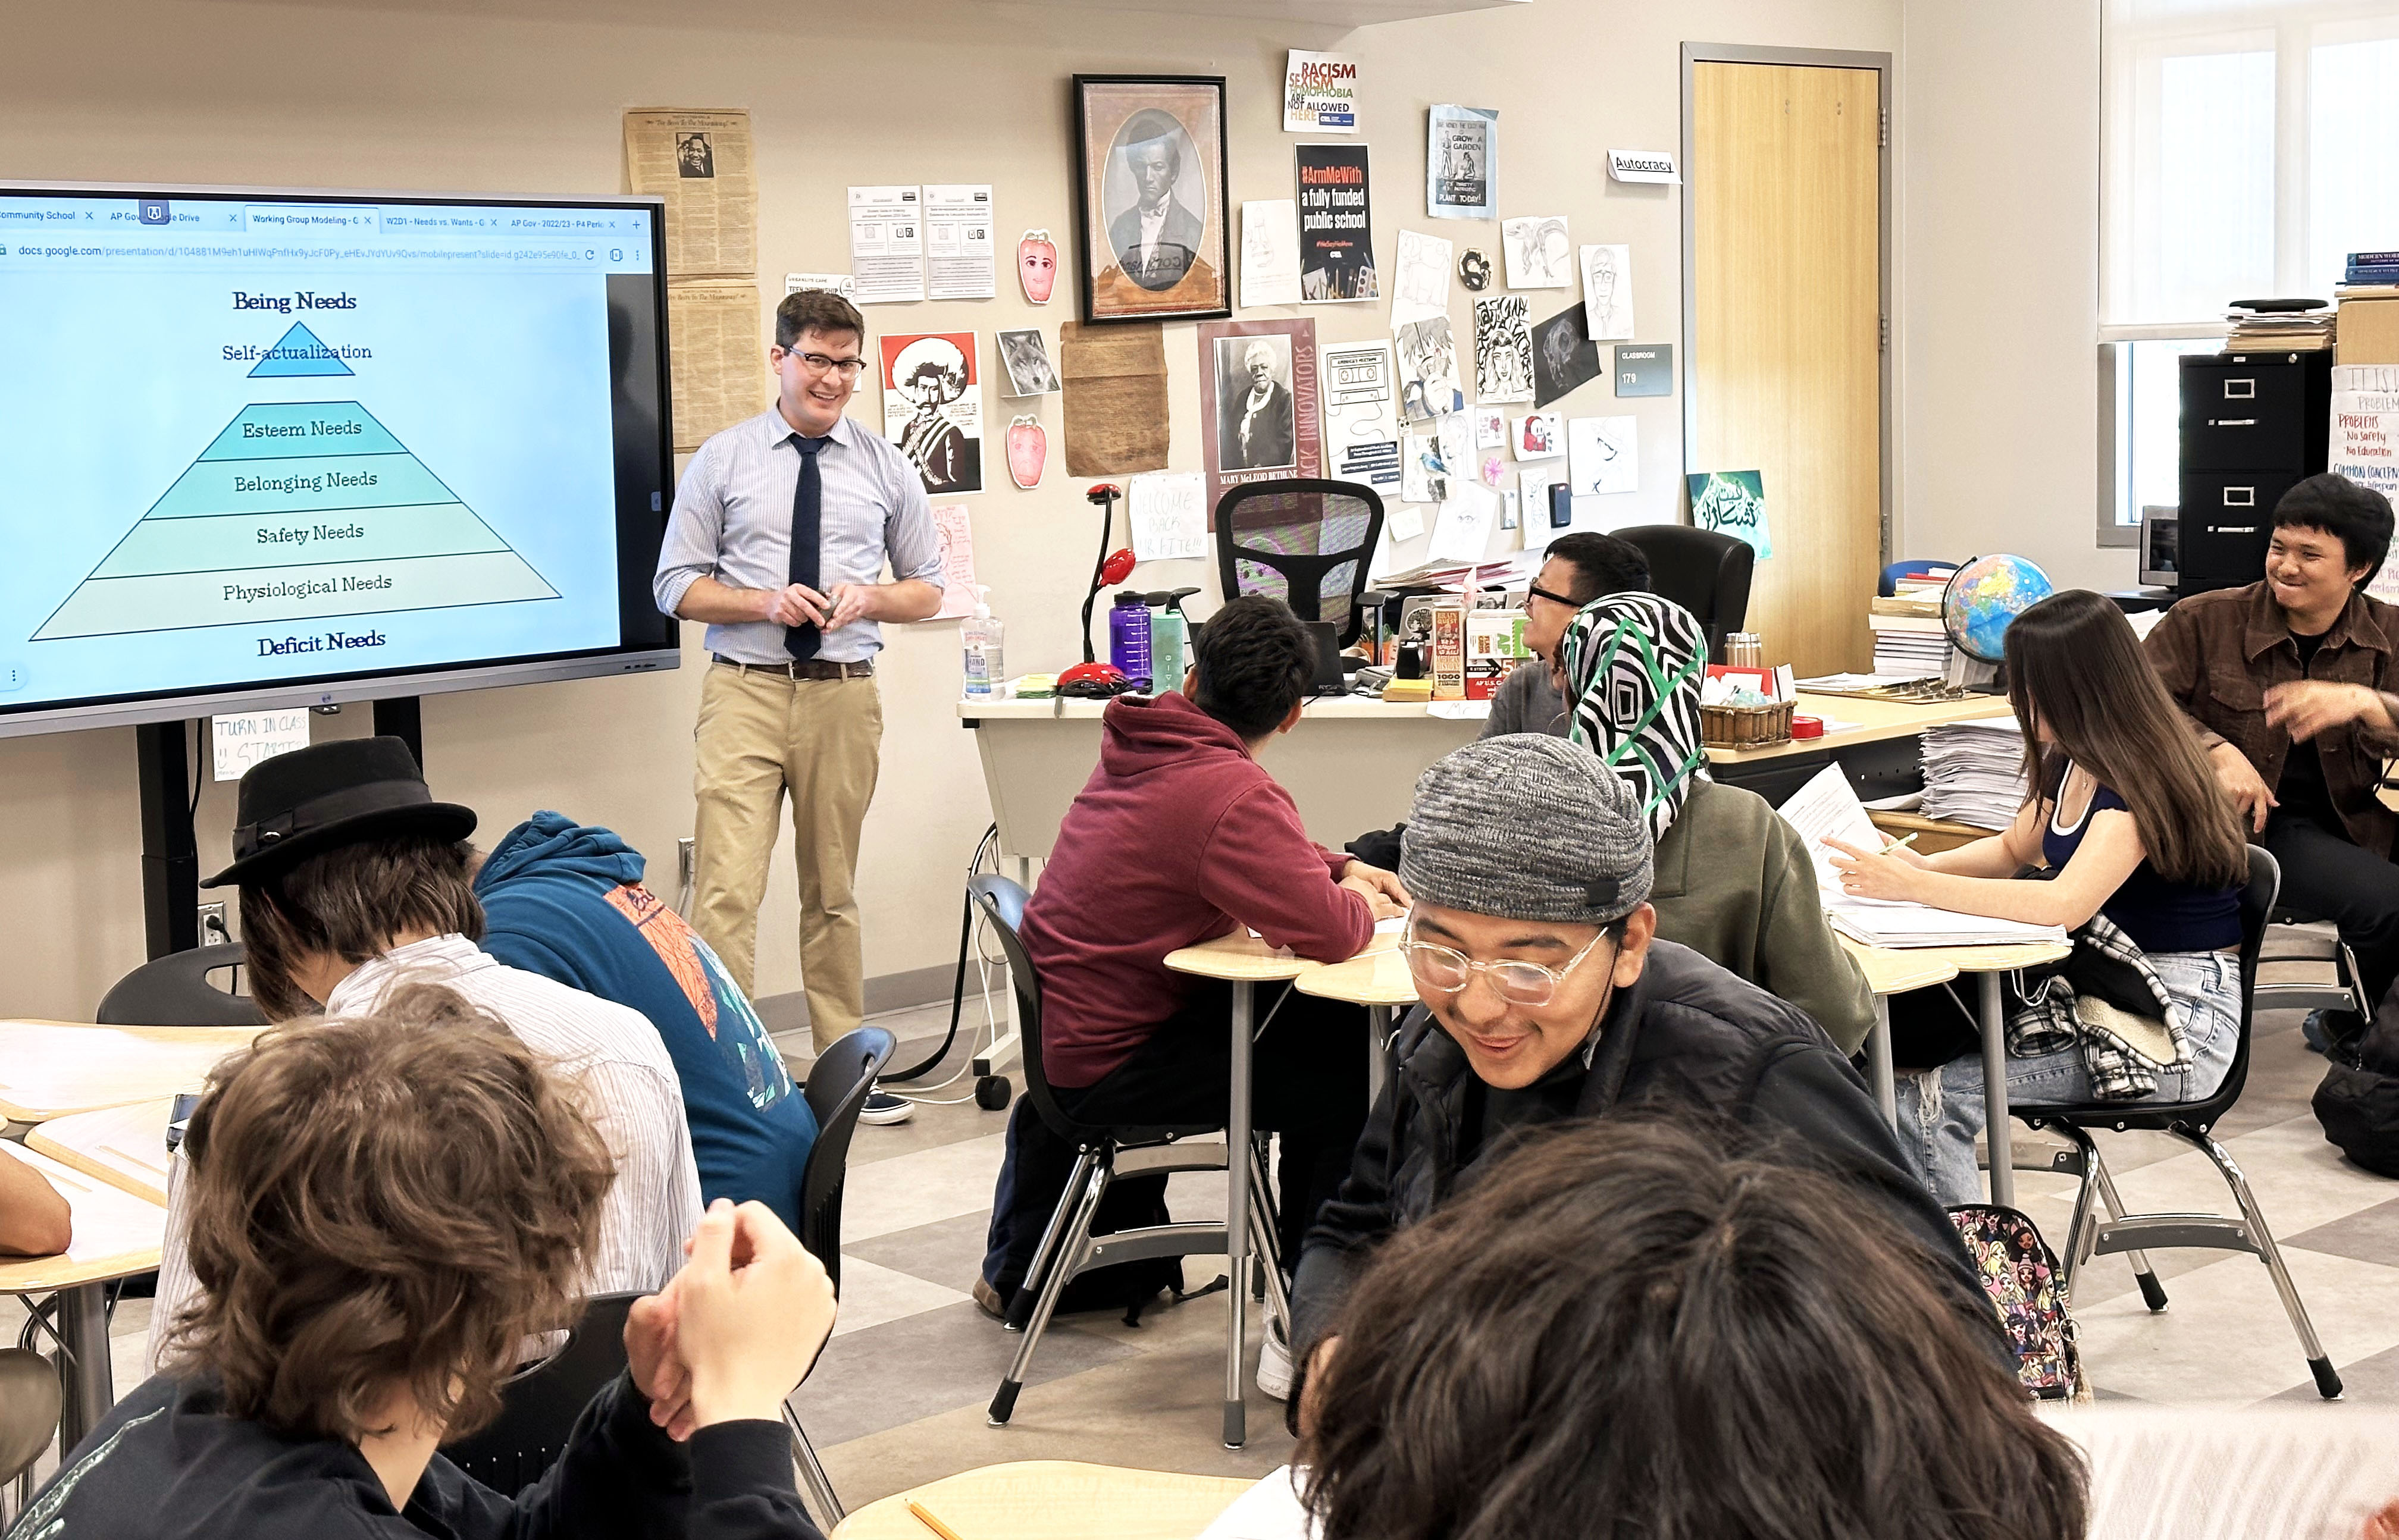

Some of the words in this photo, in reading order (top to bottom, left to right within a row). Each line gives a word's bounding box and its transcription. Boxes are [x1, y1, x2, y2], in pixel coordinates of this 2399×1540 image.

[1302, 62, 1356, 79] RACISM
[1289, 73, 1333, 90] SEXISM
[1290, 85, 1354, 98] HOMOPHOBIA
[1291, 93, 1305, 103] ARE
[1288, 101, 1304, 111] NOT
[1307, 102, 1349, 112] ALLOWED
[1291, 109, 1317, 121] HERE
[1616, 156, 1672, 173] Autocracy
[1302, 166, 1363, 184] #ArmMeWith
[1301, 192, 1308, 206] a
[1309, 189, 1330, 209] fully
[1332, 188, 1364, 206] funded
[46, 211, 76, 220] School
[111, 212, 122, 221] AP
[179, 214, 200, 222] Drive
[253, 215, 284, 225] Working
[286, 215, 309, 225] Group
[311, 215, 346, 226] Modeling
[386, 218, 408, 226] W2D1
[414, 218, 438, 227] Needs
[451, 218, 474, 227] Wants
[1304, 211, 1333, 232] public
[1335, 210, 1366, 229] school
[522, 220, 536, 228] Gov
[542, 220, 571, 230] 2022/23
[231, 291, 292, 314] Being
[295, 291, 357, 309] Needs
[222, 343, 372, 362] Self-actualization
[1621, 352, 1656, 360] CLASSROOM
[1622, 373, 1636, 384] 179
[1295, 346, 1317, 441] INNOVATORS
[242, 421, 306, 440] Esteem
[310, 419, 362, 437] Needs
[2338, 413, 2379, 429] PROBLEMS
[2347, 431, 2358, 441] No
[2360, 431, 2386, 446] Safety
[2346, 446, 2356, 456] No
[2357, 446, 2392, 457] Education
[1219, 473, 1239, 485] MARY
[1241, 472, 1267, 484] McLEOD
[1268, 469, 1298, 481] BETHUNE
[2334, 463, 2365, 478] COMMON
[234, 473, 322, 495] Belonging
[326, 471, 378, 489] Needs
[1135, 491, 1191, 515] WELCOME
[1149, 516, 1180, 533] BACK
[256, 525, 309, 546] Safety
[312, 523, 364, 541] Needs
[223, 577, 338, 604] Physiological
[342, 575, 392, 593] Needs
[256, 634, 322, 657] Deficit
[325, 630, 386, 651] Needs
[1497, 633, 1511, 655] AP
[968, 658, 985, 667] HAND
[1436, 662, 1460, 670] HISTORY
[1502, 659, 1514, 676] 5
[215, 719, 257, 736] TURN
[262, 717, 276, 733] IN
[278, 716, 306, 732] CLASS
